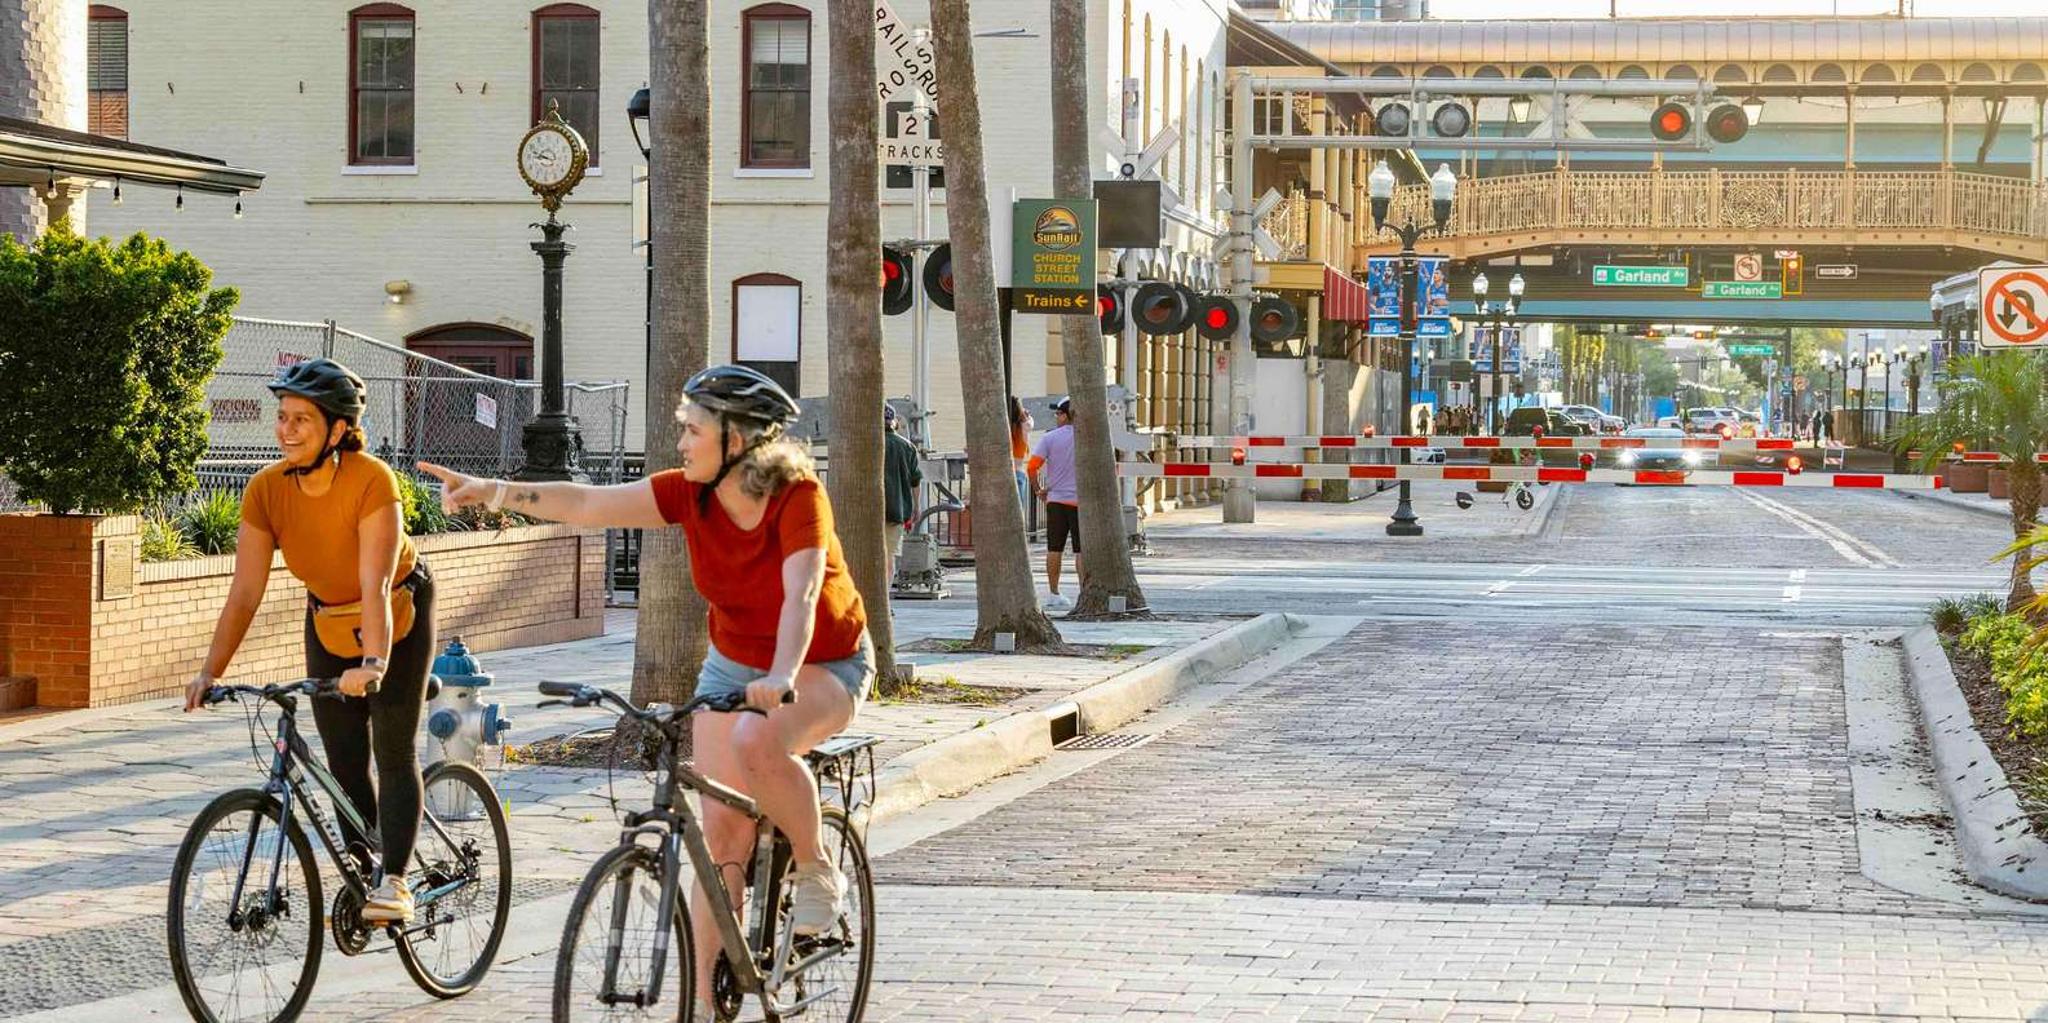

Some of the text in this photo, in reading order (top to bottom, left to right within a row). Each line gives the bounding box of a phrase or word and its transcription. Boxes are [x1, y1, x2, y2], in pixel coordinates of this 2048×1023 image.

[905, 116, 917, 135] 2
[880, 145, 943, 159] RACKS
[1036, 233, 1078, 244] SunRail
[1033, 253, 1081, 263] CHURCH
[1035, 264, 1077, 273] STREET
[1034, 274, 1079, 283] STATION
[1614, 269, 1670, 283] Garland
[1720, 284, 1767, 296] Garland
[1025, 294, 1072, 307] Trains
